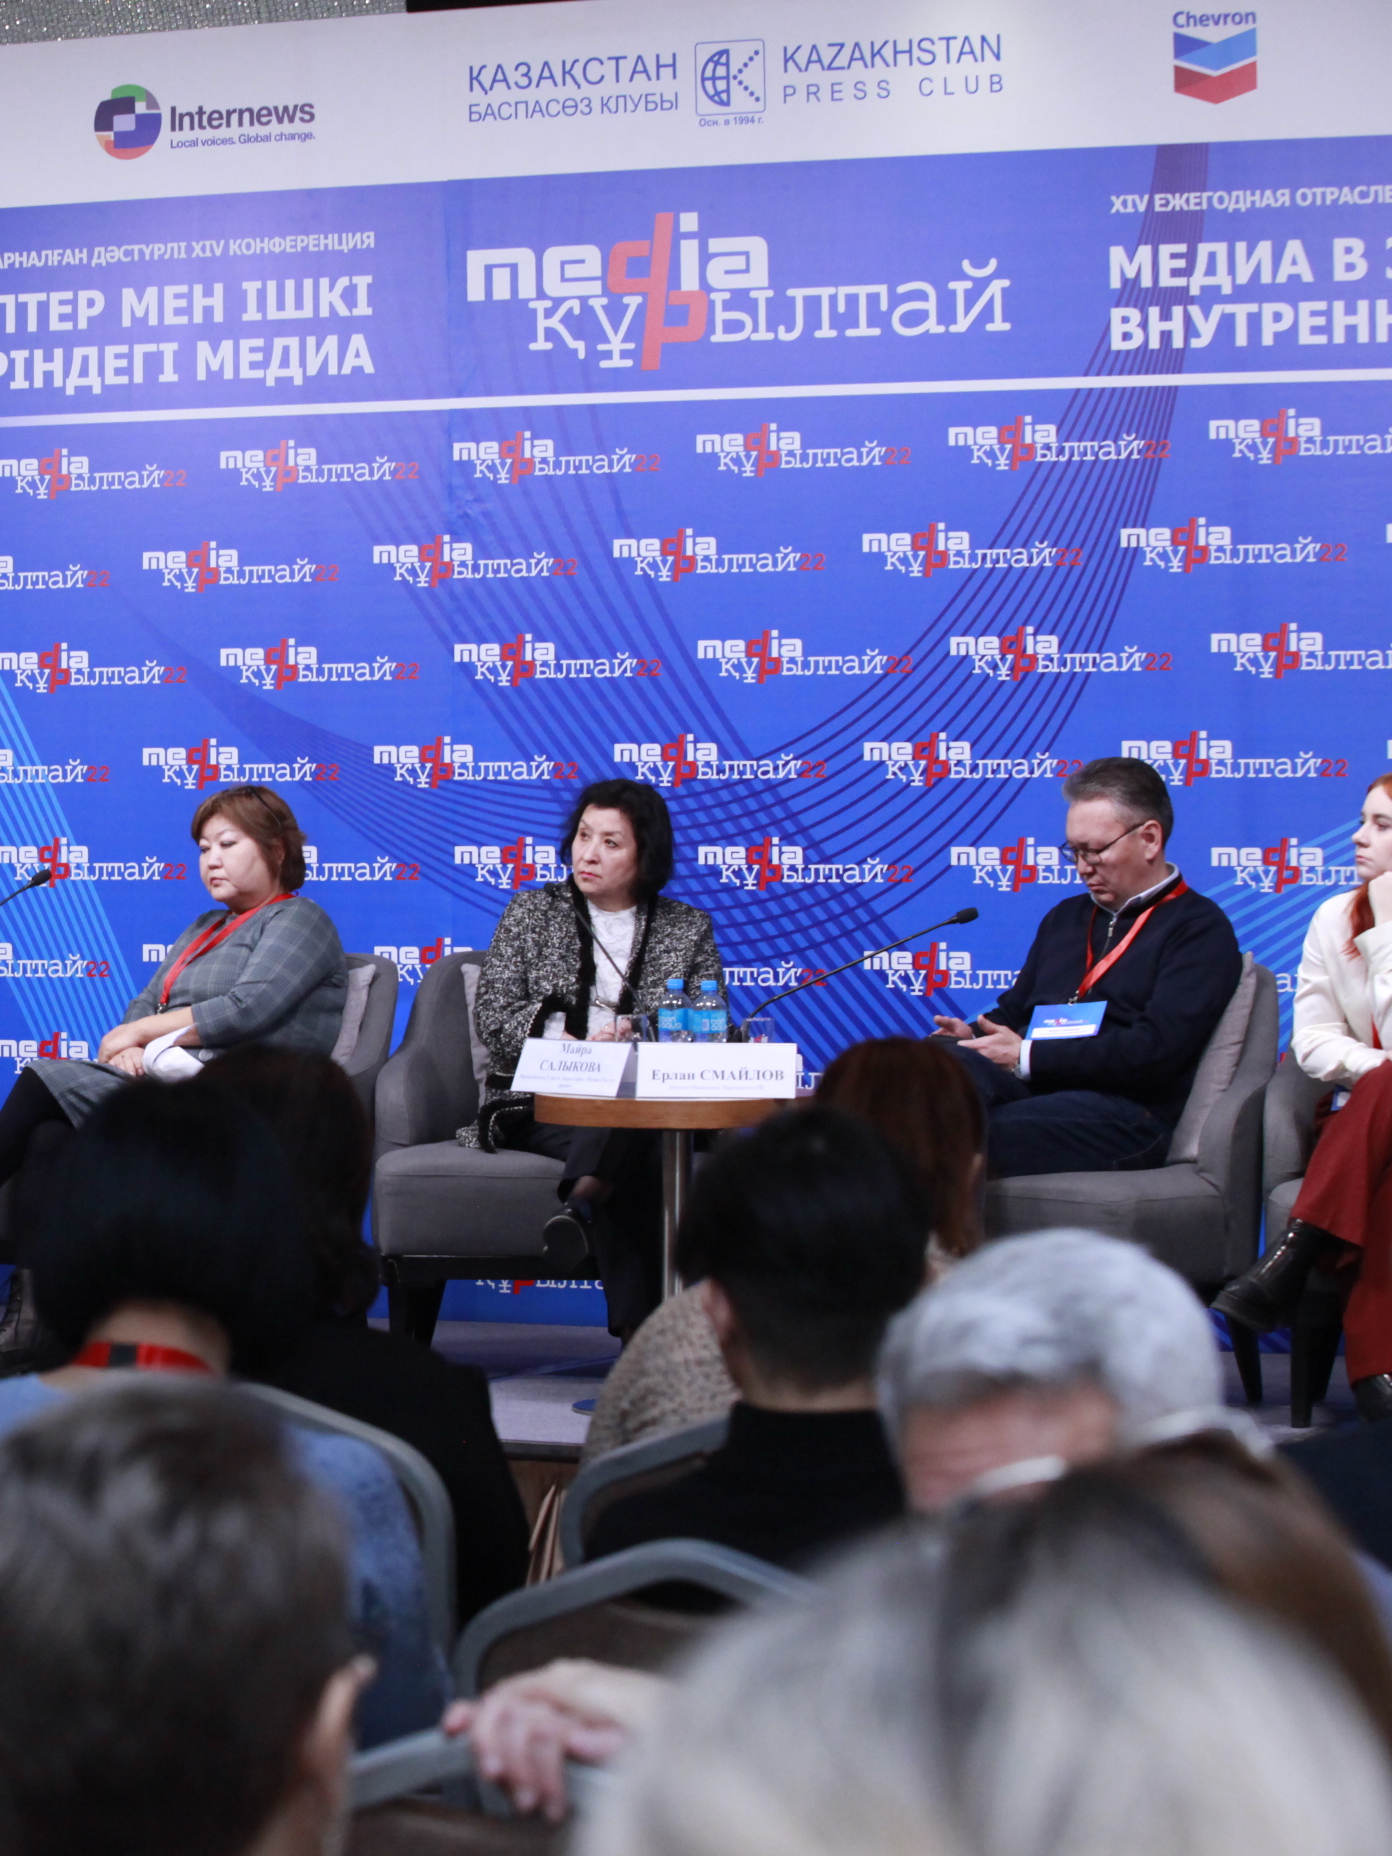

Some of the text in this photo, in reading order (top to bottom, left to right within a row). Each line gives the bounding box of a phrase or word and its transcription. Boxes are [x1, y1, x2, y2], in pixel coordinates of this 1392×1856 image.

[1172, 10, 1257, 29] Chevron
[783, 34, 1001, 74] KAZAKHSTAN
[469, 52, 677, 95] ҚАЗАҚСТАН
[783, 73, 1003, 104] PRESS CLUB
[170, 102, 316, 132] Internews
[468, 91, 678, 123] БАСПАСӨЗ КЛУБЫ
[698, 117, 721, 128] Осн.
[724, 118, 730, 126] в
[732, 115, 755, 126] 1994
[170, 130, 316, 149] Local voices. Global change.
[1110, 194, 1150, 214] XIV
[1154, 188, 1290, 213] ЕЖЕГОДНАЯ
[191, 239, 225, 258] XIV
[229, 231, 375, 257] КОНФЕРЕНЦИЯ
[466, 211, 769, 301] media
[1109, 239, 1315, 296] МЕДИА
[1332, 237, 1369, 282] В
[121, 282, 224, 328] МЕН
[241, 275, 374, 321] ІШКІ
[528, 258, 1011, 370] құрылтай
[196, 333, 375, 387] МЕДИА
[695, 422, 801, 453] media
[948, 415, 1057, 445] media
[1209, 408, 1321, 440] media
[219, 439, 317, 469] media
[452, 430, 554, 460] media
[613, 527, 717, 557] media
[862, 522, 970, 552] media
[1120, 516, 1231, 547] media
[142, 540, 238, 569] media
[372, 534, 472, 563] media
[219, 637, 317, 666] media
[453, 633, 555, 662] media
[697, 629, 803, 658] media
[949, 625, 1058, 655] media
[1210, 622, 1323, 653] media
[142, 738, 238, 765] media
[373, 735, 474, 763] media
[614, 733, 718, 762] media
[863, 732, 971, 760] media
[1121, 730, 1233, 760] media
[454, 836, 556, 865] media
[698, 836, 804, 864] media
[950, 836, 1060, 866] media
[1210, 837, 1324, 867] media
[863, 941, 971, 970] media
[559, 1043, 593, 1057] Майра
[539, 1059, 601, 1073] САЛЫКОВА
[651, 1067, 785, 1083] Ерлан СМАЙЛОВ
